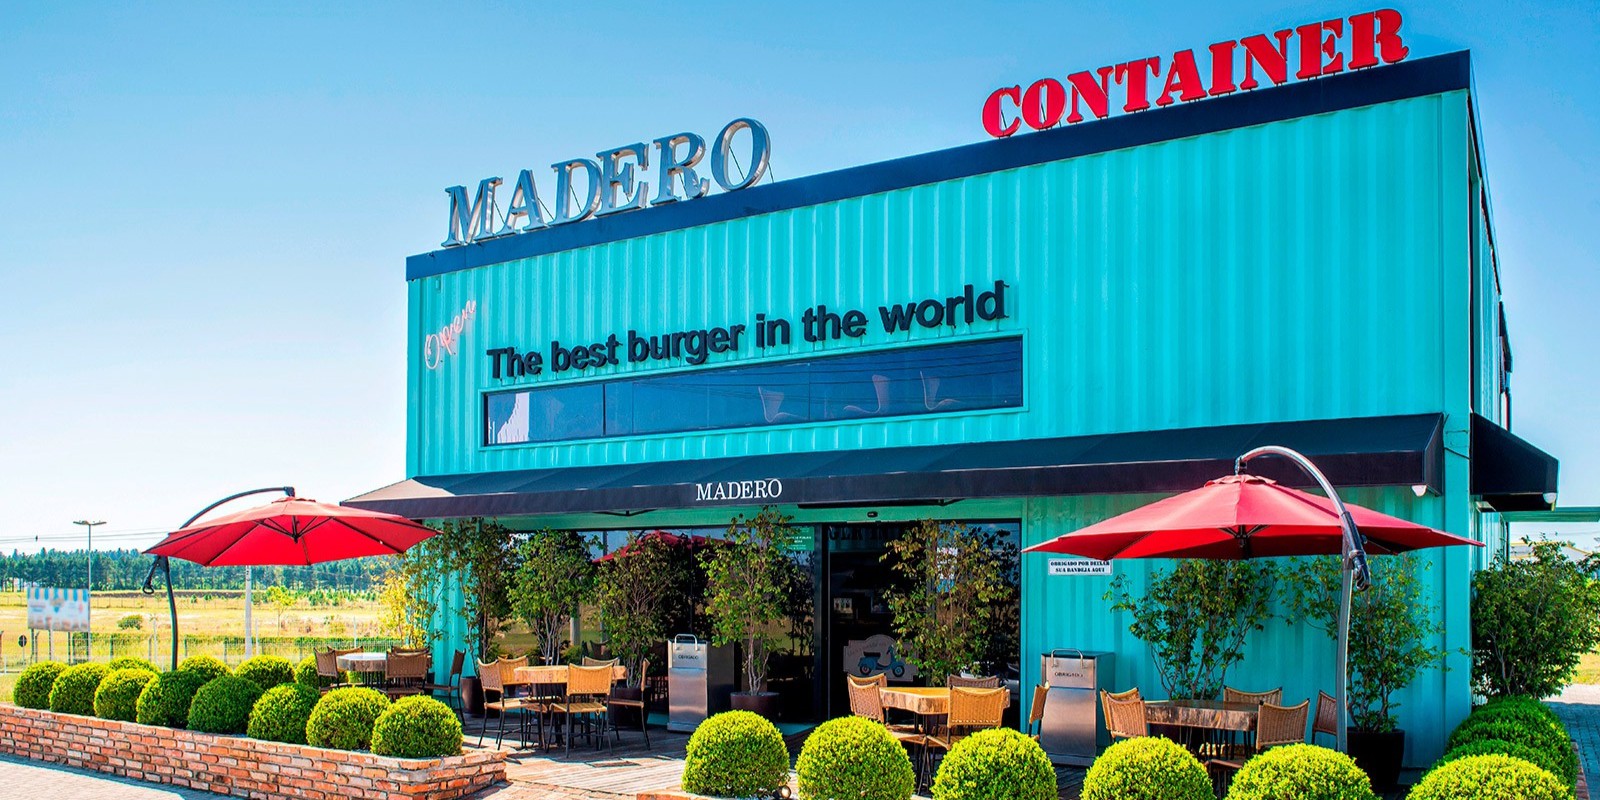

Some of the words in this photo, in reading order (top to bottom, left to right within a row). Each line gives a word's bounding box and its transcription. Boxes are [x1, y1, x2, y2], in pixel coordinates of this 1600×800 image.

[981, 8, 1409, 138] CONTAINER
[440, 117, 772, 247] MADERO
[425, 300, 476, 369] Open
[487, 346, 543, 379] The
[551, 333, 621, 372] best
[627, 324, 745, 364] burger
[756, 313, 790, 348] in
[802, 304, 867, 342] the
[878, 280, 1007, 334] world
[695, 478, 783, 501] MADERO
